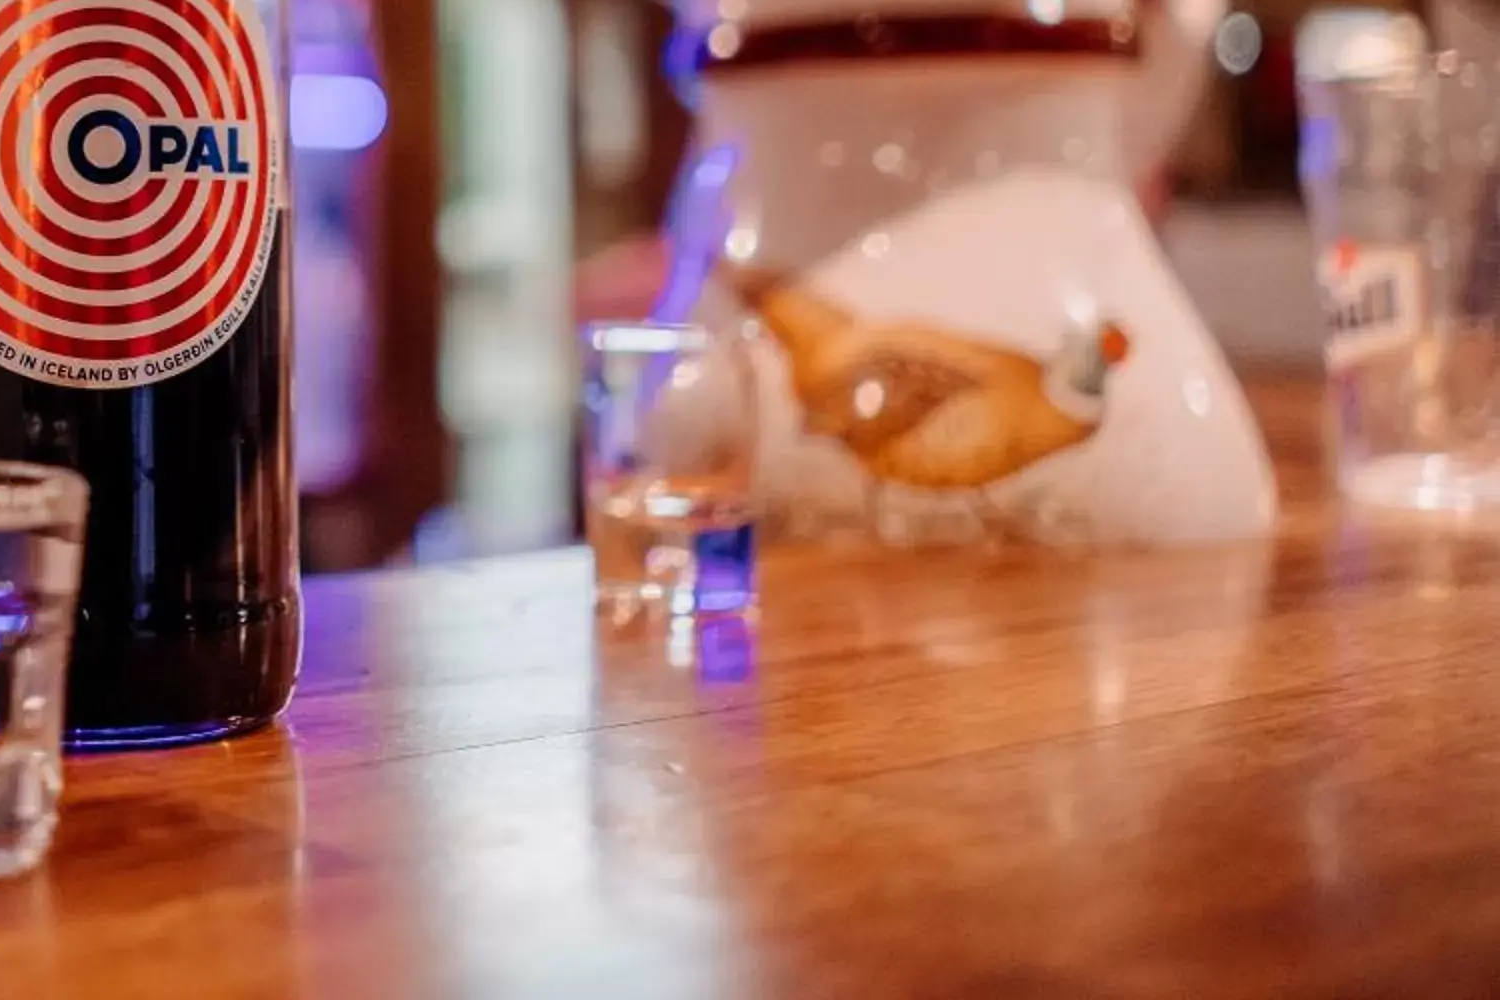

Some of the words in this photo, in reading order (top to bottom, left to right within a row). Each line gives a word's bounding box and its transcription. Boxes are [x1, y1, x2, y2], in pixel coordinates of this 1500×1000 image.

[68, 109, 249, 185] OPAL
[19, 353, 38, 370] IN
[40, 361, 113, 382] ICELAND
[118, 366, 140, 382] BY
